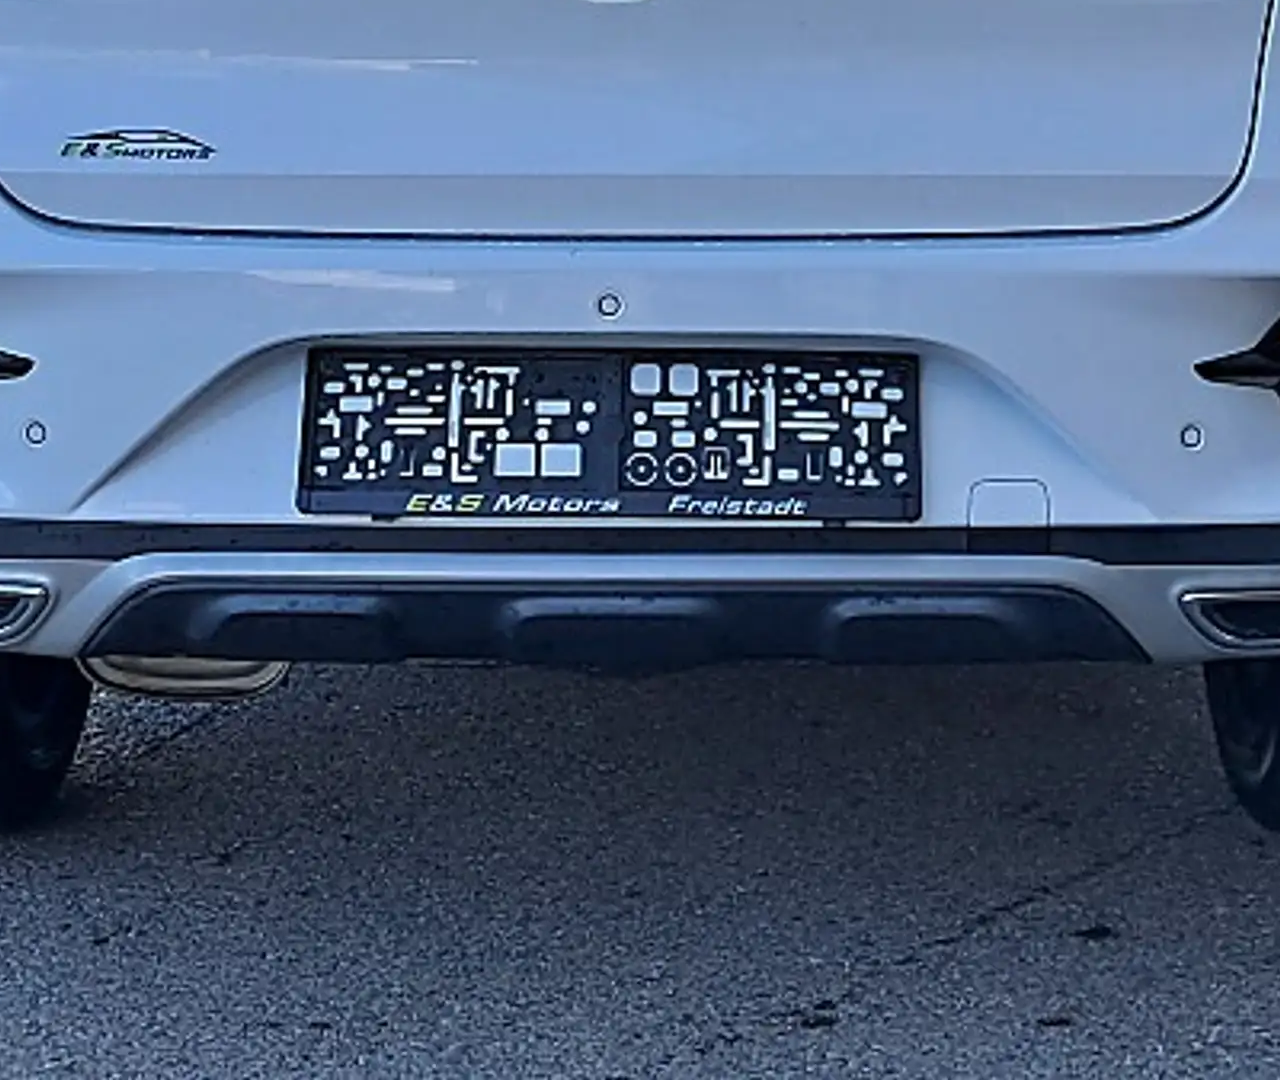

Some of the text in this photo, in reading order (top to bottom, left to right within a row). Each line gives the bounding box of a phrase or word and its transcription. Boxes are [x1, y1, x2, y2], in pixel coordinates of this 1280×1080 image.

[406, 493, 809, 516] E&S Motors Freistadt
